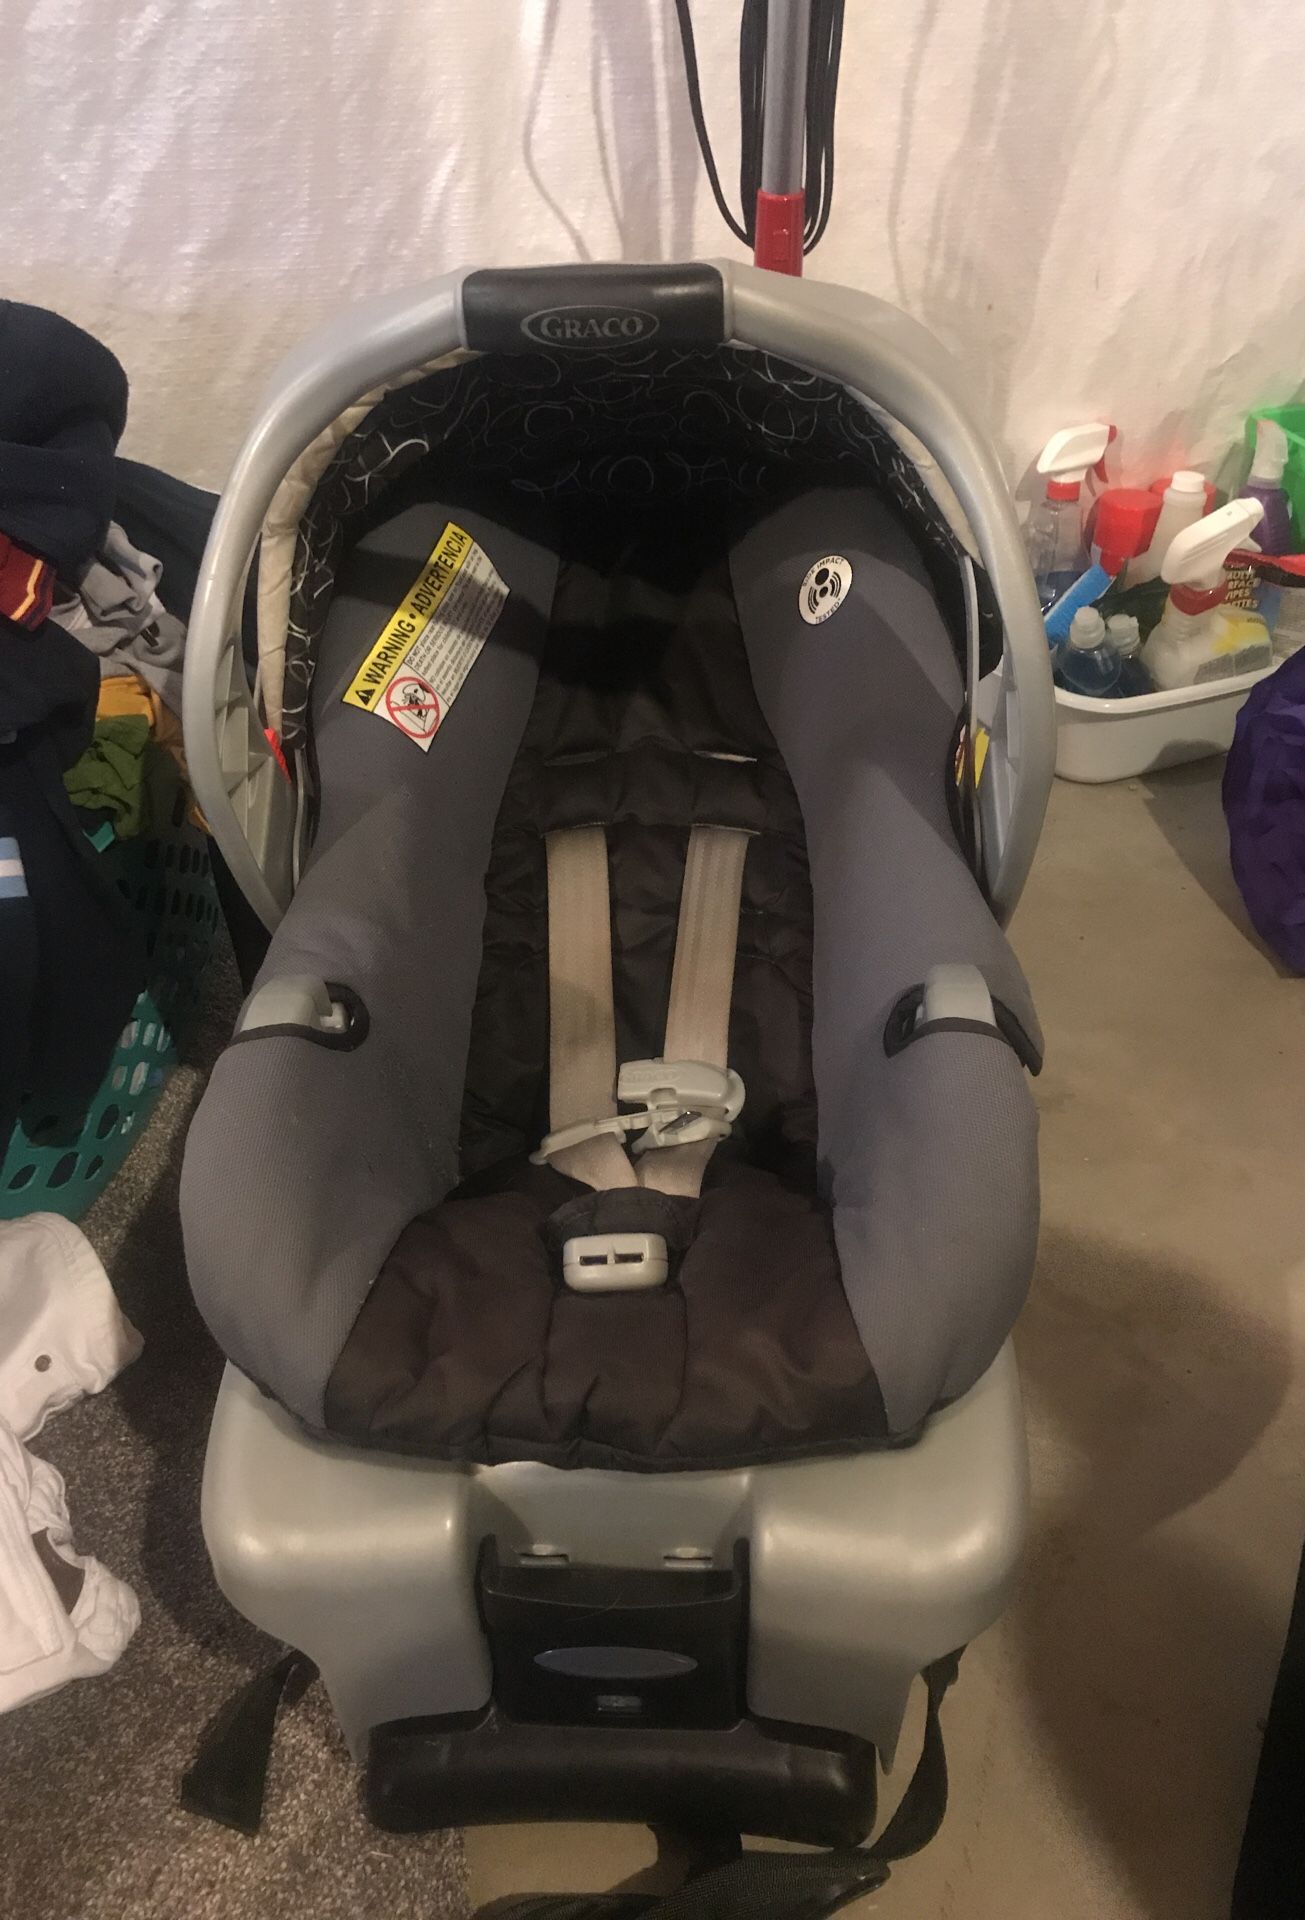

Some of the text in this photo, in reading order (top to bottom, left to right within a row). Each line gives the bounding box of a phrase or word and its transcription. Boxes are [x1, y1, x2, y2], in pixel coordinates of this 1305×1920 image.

[540, 316, 644, 338] GRACO
[816, 557, 845, 570] IMPACT
[362, 530, 467, 686] WARNING ADVERTENCIA
